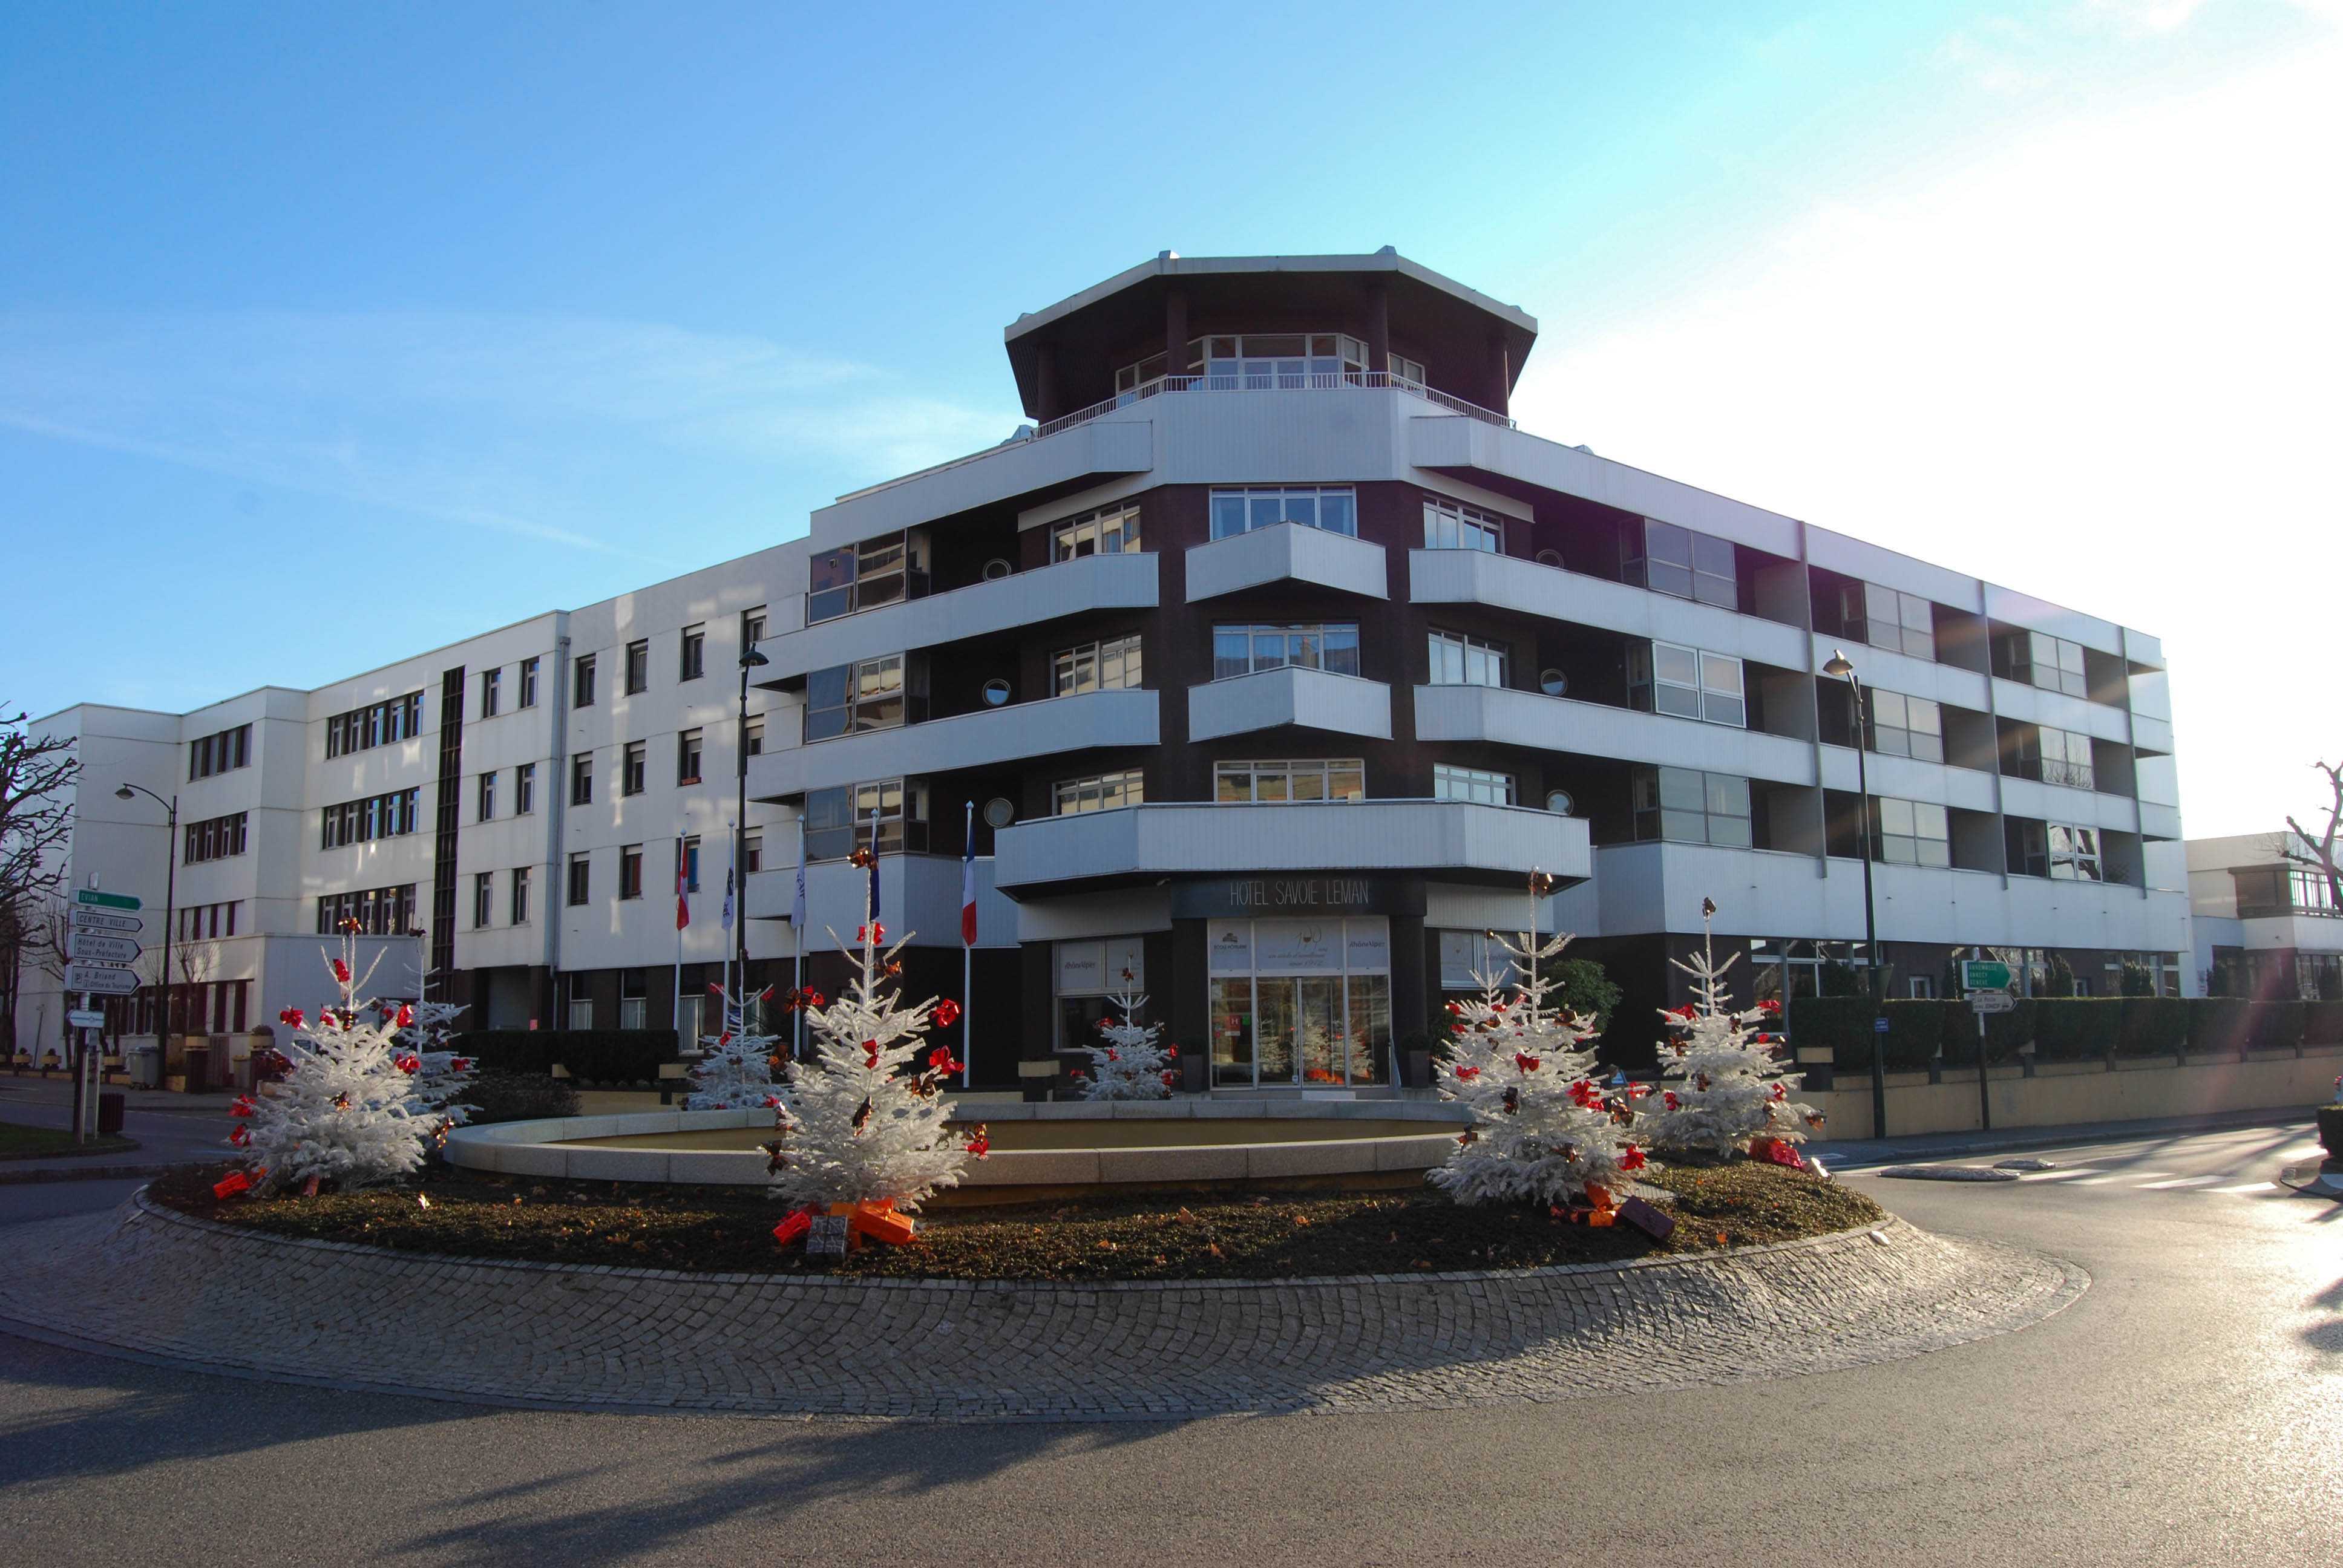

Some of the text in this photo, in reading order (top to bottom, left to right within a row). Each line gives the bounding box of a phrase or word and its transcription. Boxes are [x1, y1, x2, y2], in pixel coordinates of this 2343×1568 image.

[81, 893, 98, 901] EVIAN
[1230, 880, 1369, 906] HOTEL SAVOIE LEMAN
[79, 914, 126, 927] CENTRE VILLE
